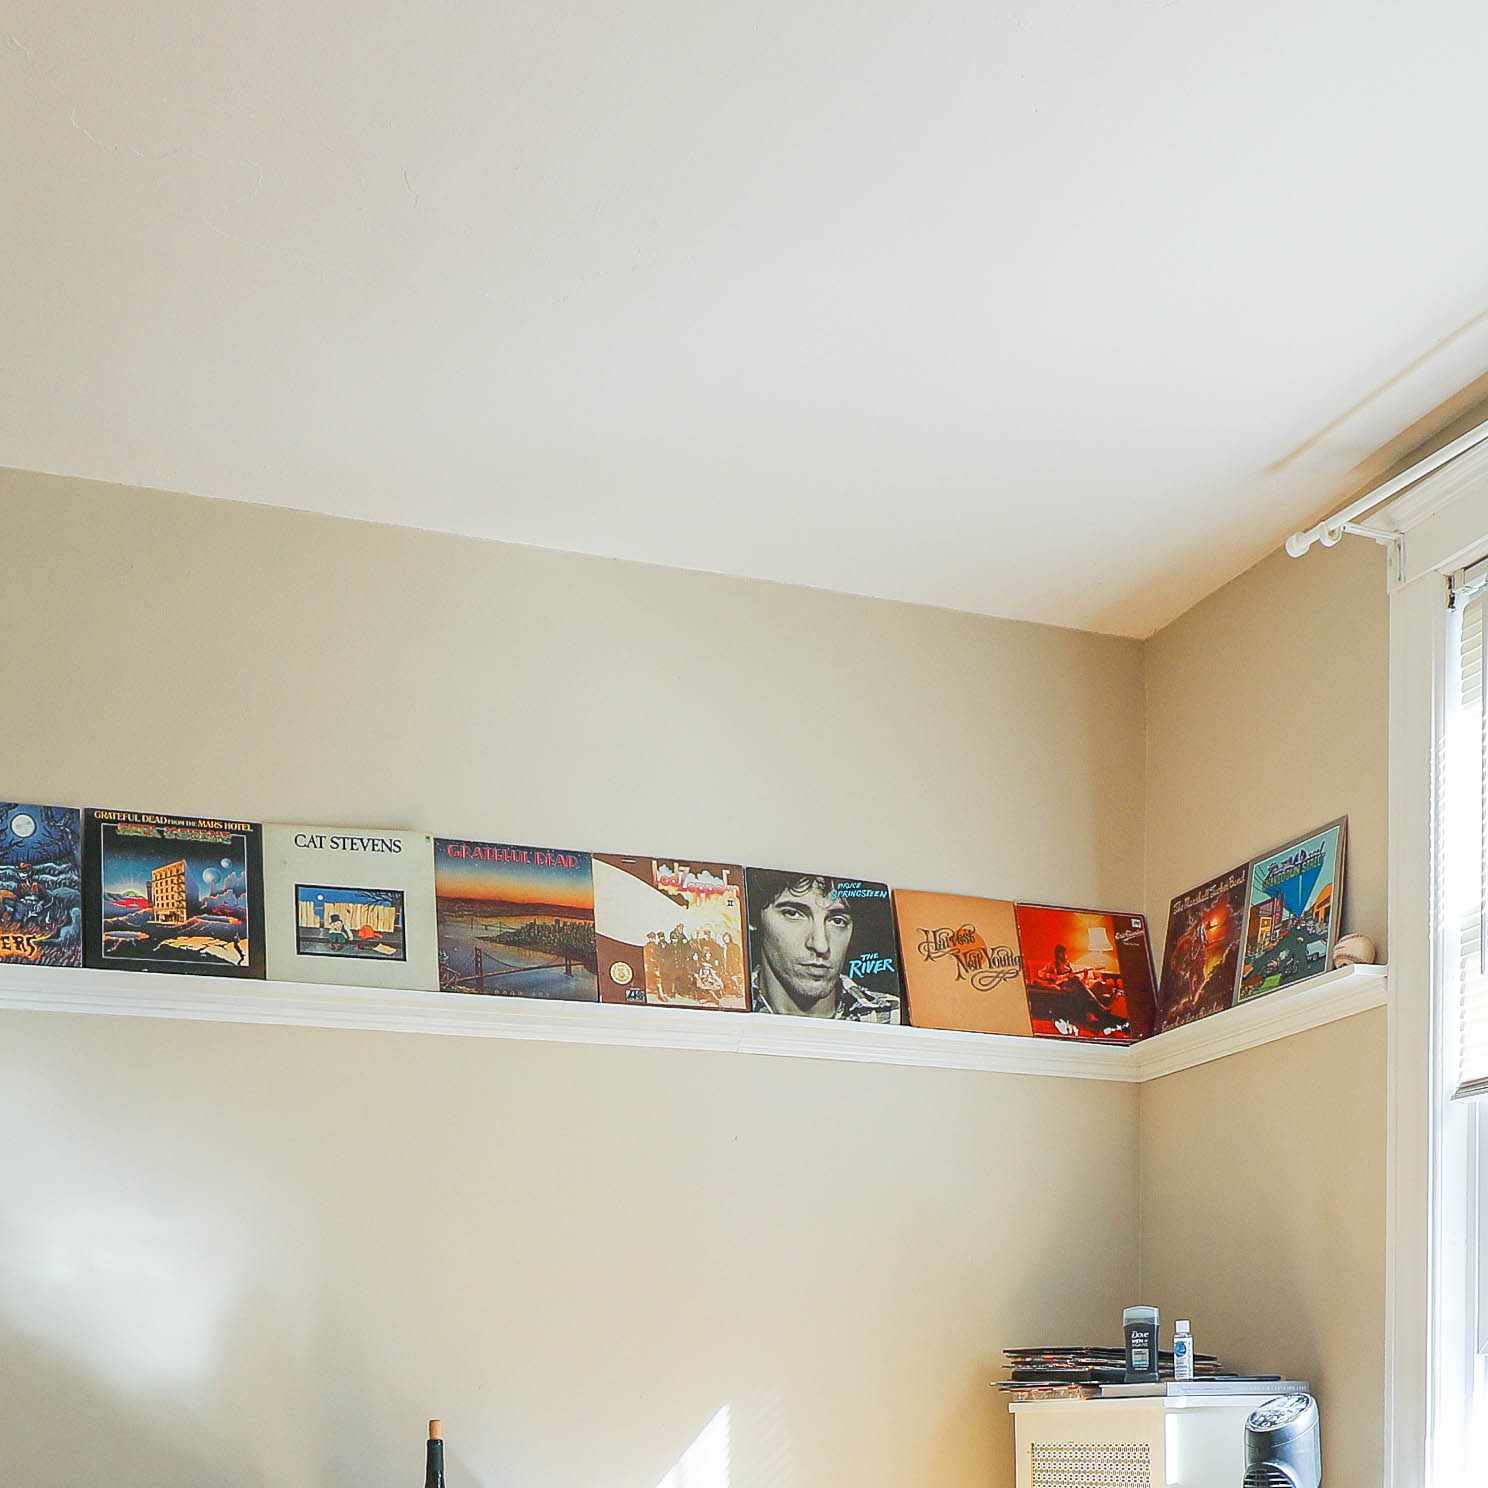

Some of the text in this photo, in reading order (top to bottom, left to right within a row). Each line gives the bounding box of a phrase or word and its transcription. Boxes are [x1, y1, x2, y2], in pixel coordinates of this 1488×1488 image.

[94, 811, 141, 822] GRATEFUL
[142, 814, 167, 825] DEAD
[198, 819, 223, 830] MARS
[224, 822, 254, 832] HOTEL
[294, 833, 402, 853] CAT STEVENS
[447, 845, 579, 869] GRATEFUL DEAD
[831, 889, 888, 899] SPRINGSTEEN
[916, 923, 976, 961] Harvest
[860, 952, 879, 961] THE
[952, 951, 983, 981] Neil
[849, 959, 895, 979] RIVER
[1131, 1331, 1149, 1339] Dove
